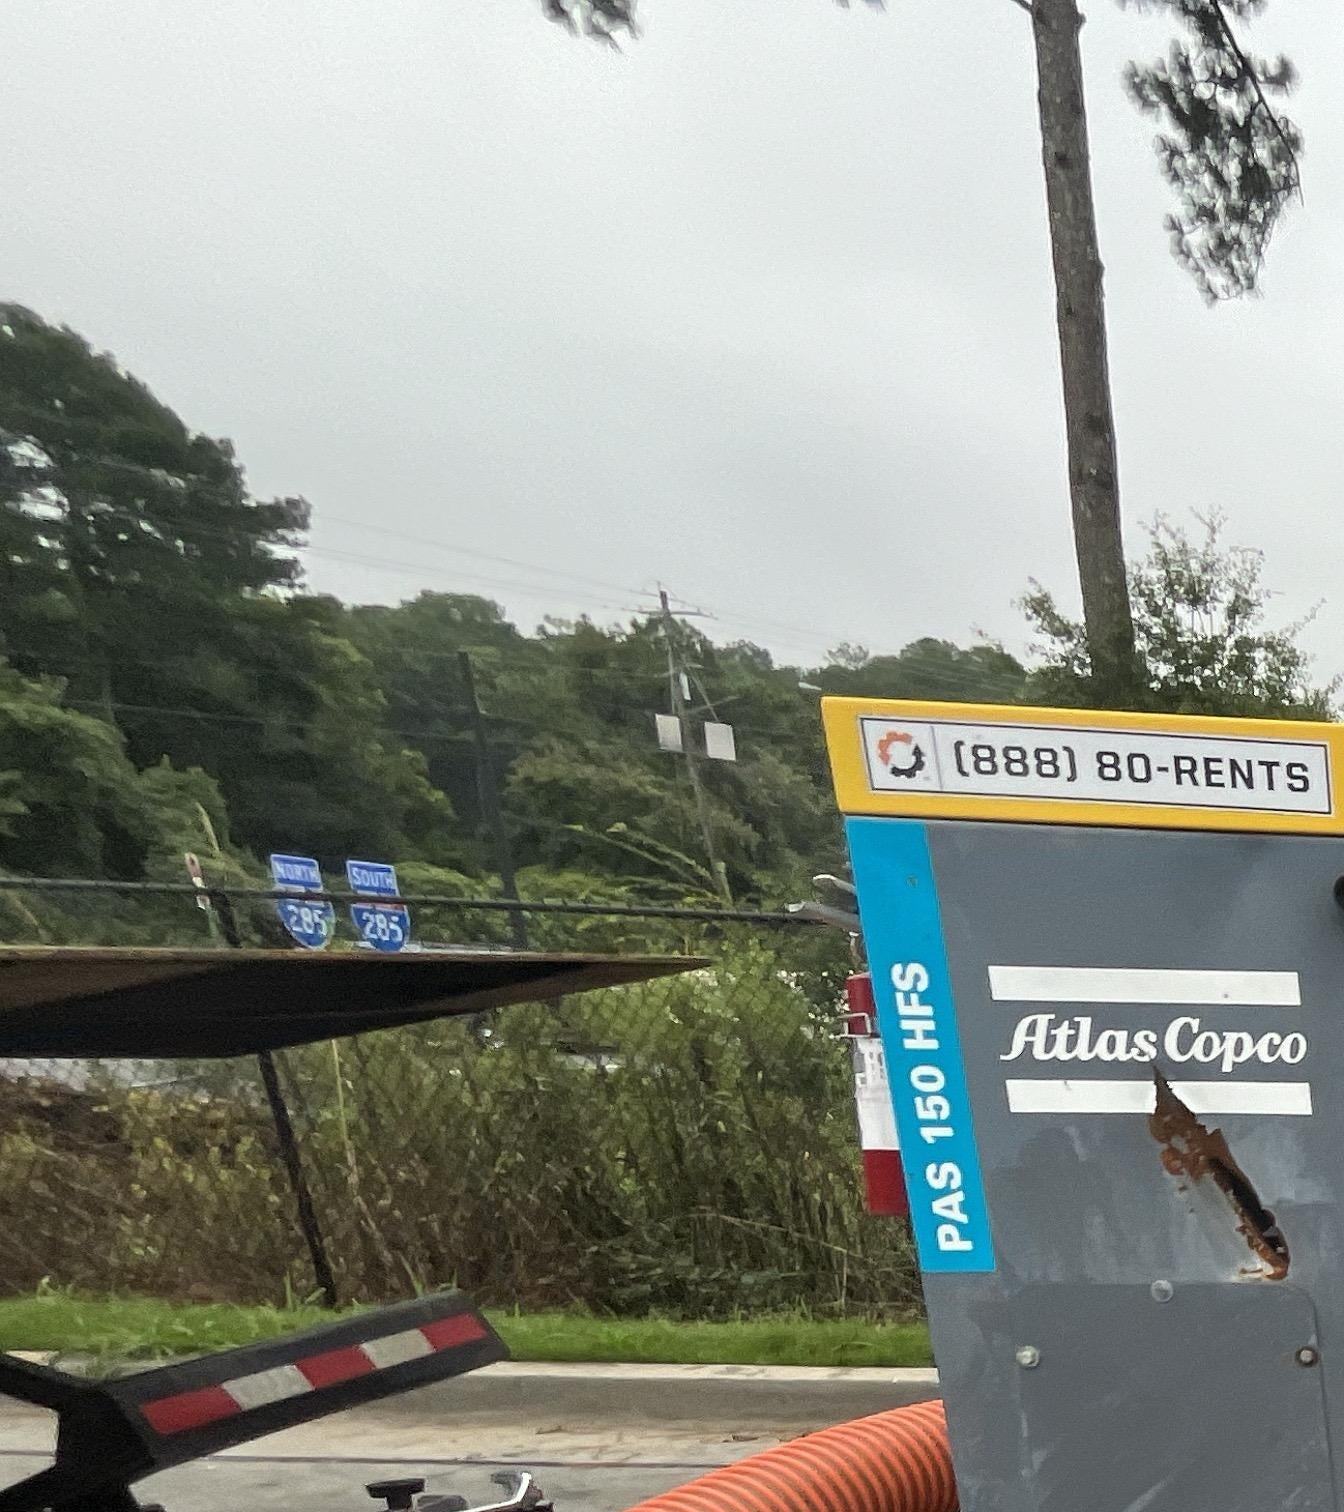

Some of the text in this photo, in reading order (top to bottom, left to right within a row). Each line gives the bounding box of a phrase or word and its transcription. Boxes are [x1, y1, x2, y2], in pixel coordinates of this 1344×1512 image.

[954, 740, 1311, 794] (888) 80-RENTS
[352, 867, 394, 887] SOUTH
[287, 904, 328, 936] 285
[361, 911, 404, 942] 285
[1000, 1013, 1308, 1073] Atlas Copco
[891, 962, 974, 1251] PAS 150 HFS
